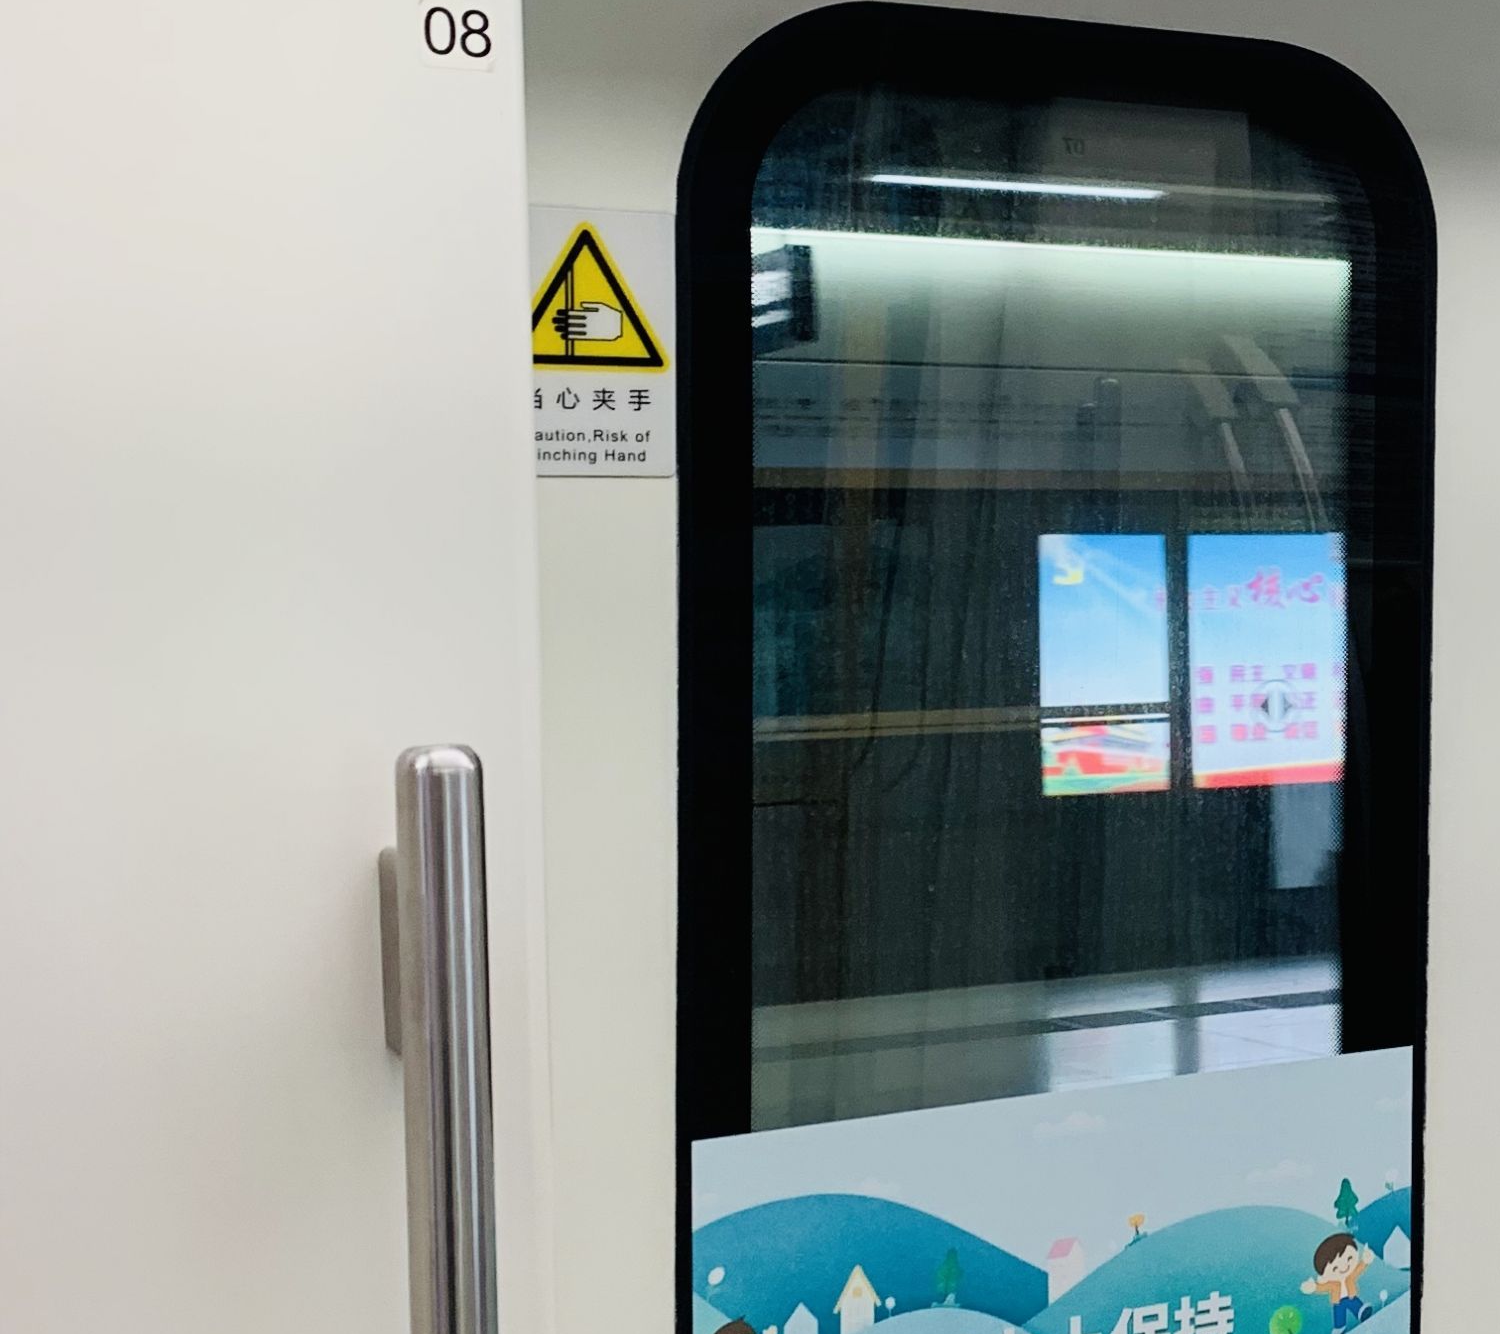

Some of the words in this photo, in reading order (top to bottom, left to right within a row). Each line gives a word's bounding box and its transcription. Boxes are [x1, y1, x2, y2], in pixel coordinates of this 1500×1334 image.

[423, 5, 493, 59] 08
[535, 429, 628, 443] aution,Risk
[635, 430, 651, 443] of
[537, 448, 597, 464] inching
[605, 449, 646, 462] Hand
